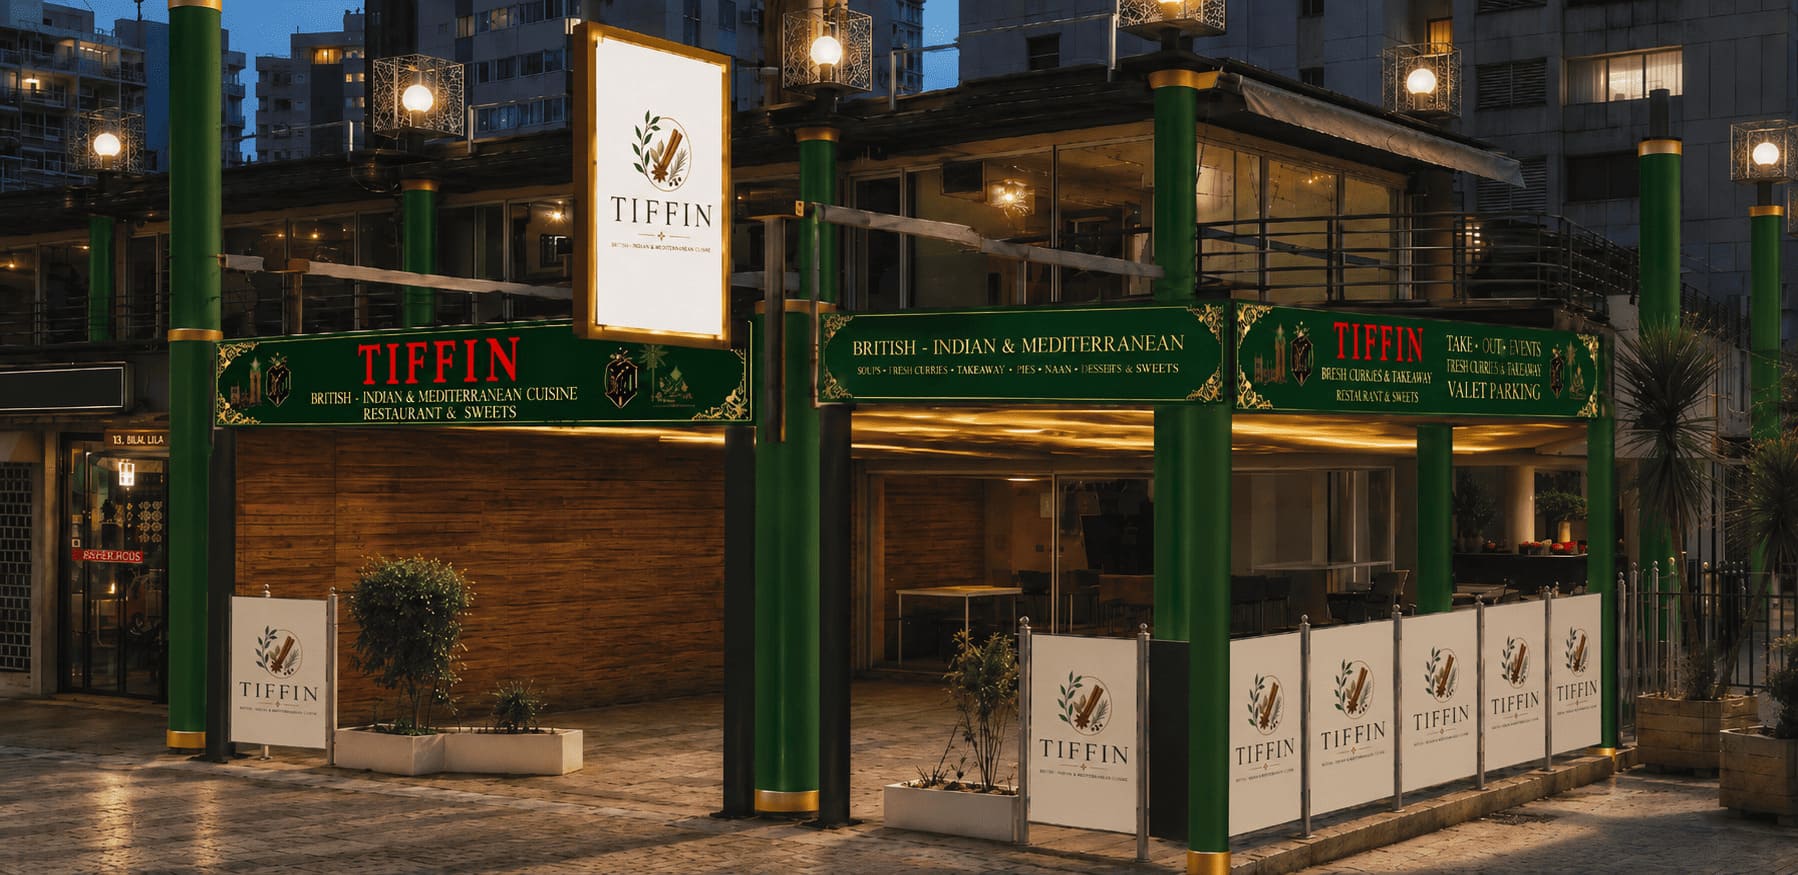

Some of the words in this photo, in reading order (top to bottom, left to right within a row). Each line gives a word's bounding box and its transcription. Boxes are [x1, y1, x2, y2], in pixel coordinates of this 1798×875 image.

[611, 196, 712, 227] TIFFIN
[853, 340, 916, 355] BRITISH
[933, 338, 996, 354] INDIAN
[1002, 338, 1015, 353] &
[1022, 335, 1185, 353] MEDITERRANEAN
[1333, 321, 1424, 363] TIFFIN
[1446, 334, 1473, 352] TAKE
[1483, 337, 1503, 355] OUT
[1510, 339, 1542, 357] EVENTS
[358, 336, 520, 385] TIFFIN
[957, 365, 1005, 375] TAKEAWAY
[1045, 364, 1072, 374] NAAN
[1136, 363, 1180, 374] SWEETS
[1384, 370, 1390, 383] &
[311, 391, 351, 404] BRITISH
[363, 391, 402, 404] INDIAN
[406, 390, 415, 403] &
[418, 387, 522, 403] MEDITERRANEAN
[526, 386, 578, 401] CUISINE
[1447, 380, 1487, 399] VALET
[1490, 382, 1541, 400] PARKING
[364, 407, 442, 420] RESTAURANT
[446, 406, 456, 419] &
[464, 405, 517, 419] SWEETS
[239, 681, 319, 702] TIFFIN
[1556, 680, 1597, 701] TIFFIN
[1491, 690, 1539, 715] TIFFIN
[1413, 704, 1469, 731] TIFFIN
[1320, 721, 1385, 750] TIFFIN
[1039, 738, 1128, 765] TIFFIN
[1235, 737, 1294, 766] TIFFIN
